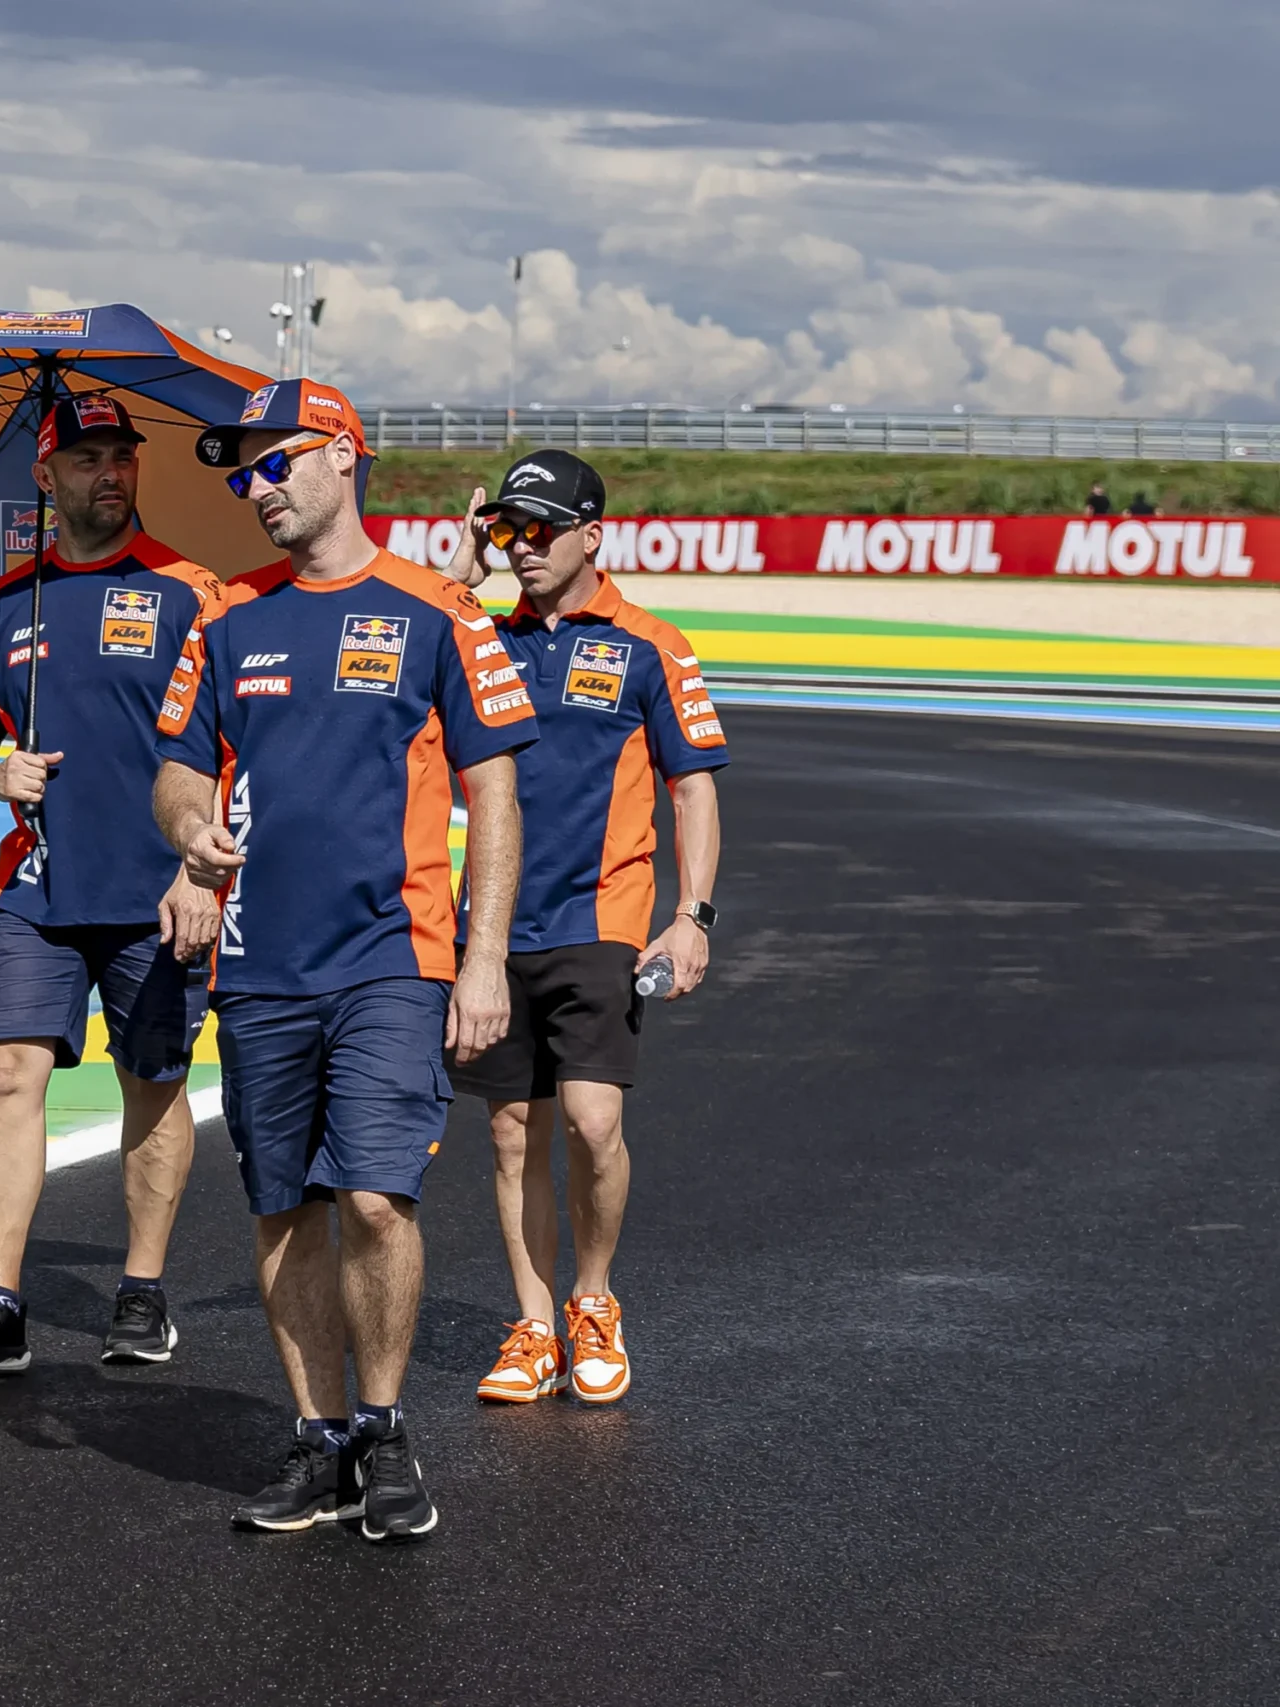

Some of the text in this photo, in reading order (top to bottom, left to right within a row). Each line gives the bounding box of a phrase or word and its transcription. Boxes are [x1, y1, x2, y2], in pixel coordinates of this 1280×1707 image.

[595, 520, 766, 574] MOTUL
[815, 519, 1002, 575] MOTUL
[1055, 520, 1255, 578] MOTUL
[106, 605, 157, 622] Red Bull
[110, 625, 147, 640] KTM
[343, 635, 403, 653] Red Bull
[240, 653, 290, 669] WP
[347, 658, 391, 674] KTM
[572, 656, 625, 675] Red Bull
[237, 678, 287, 695] MOTUL
[575, 676, 613, 693] KTM
